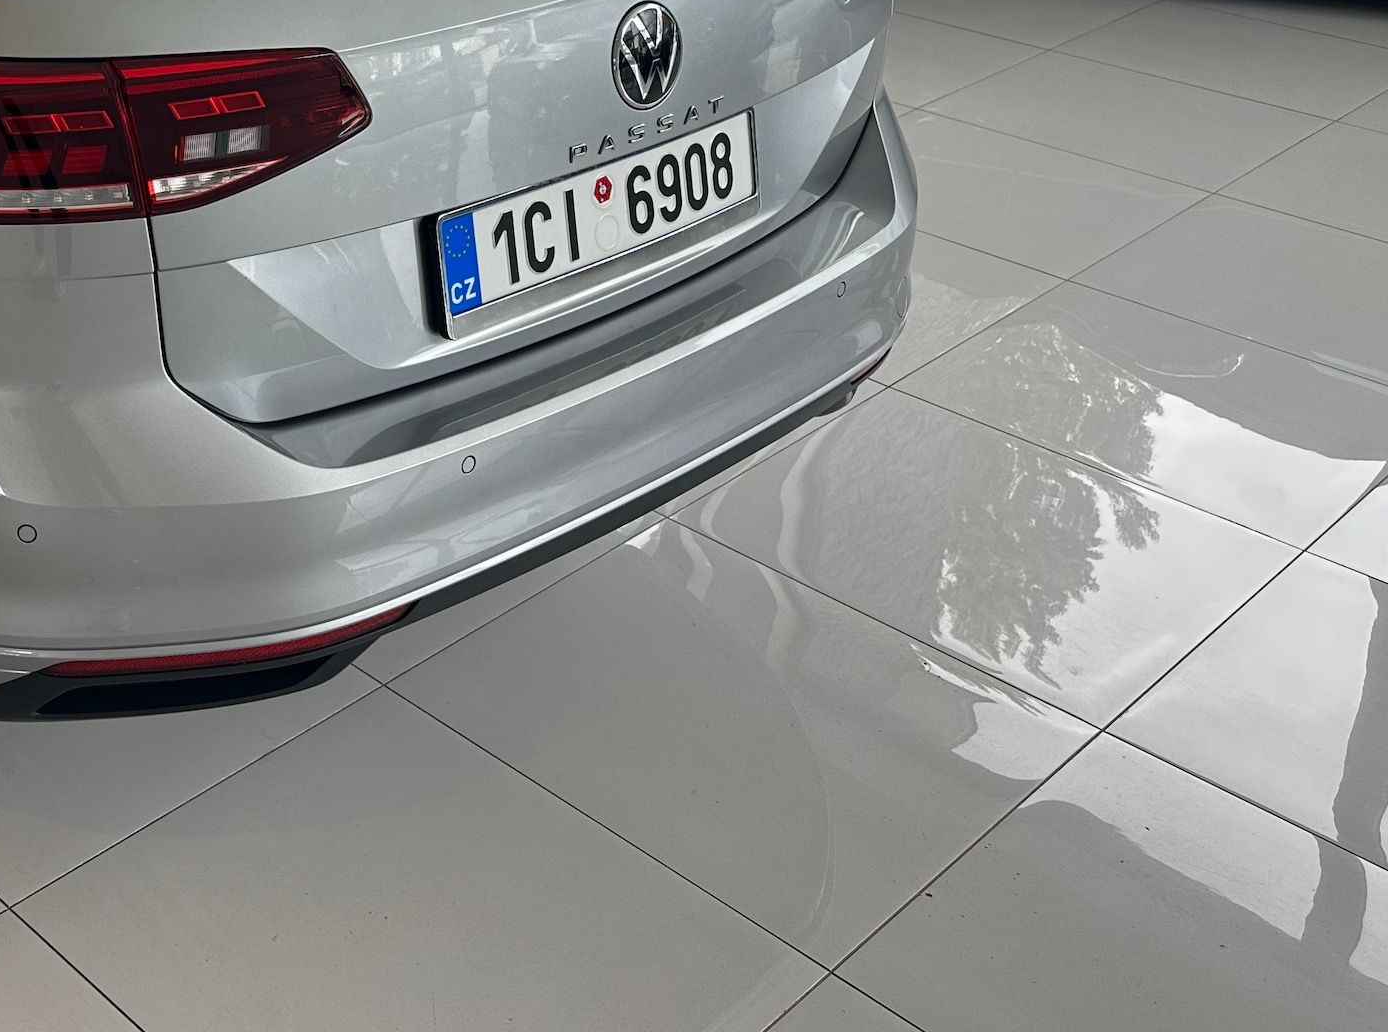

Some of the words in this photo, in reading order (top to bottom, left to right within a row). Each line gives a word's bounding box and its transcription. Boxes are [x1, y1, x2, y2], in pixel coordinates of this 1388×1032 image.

[569, 95, 725, 164] PASSAT
[492, 189, 580, 285] 1CI
[626, 132, 735, 234] 6908
[451, 276, 477, 305] CZ
